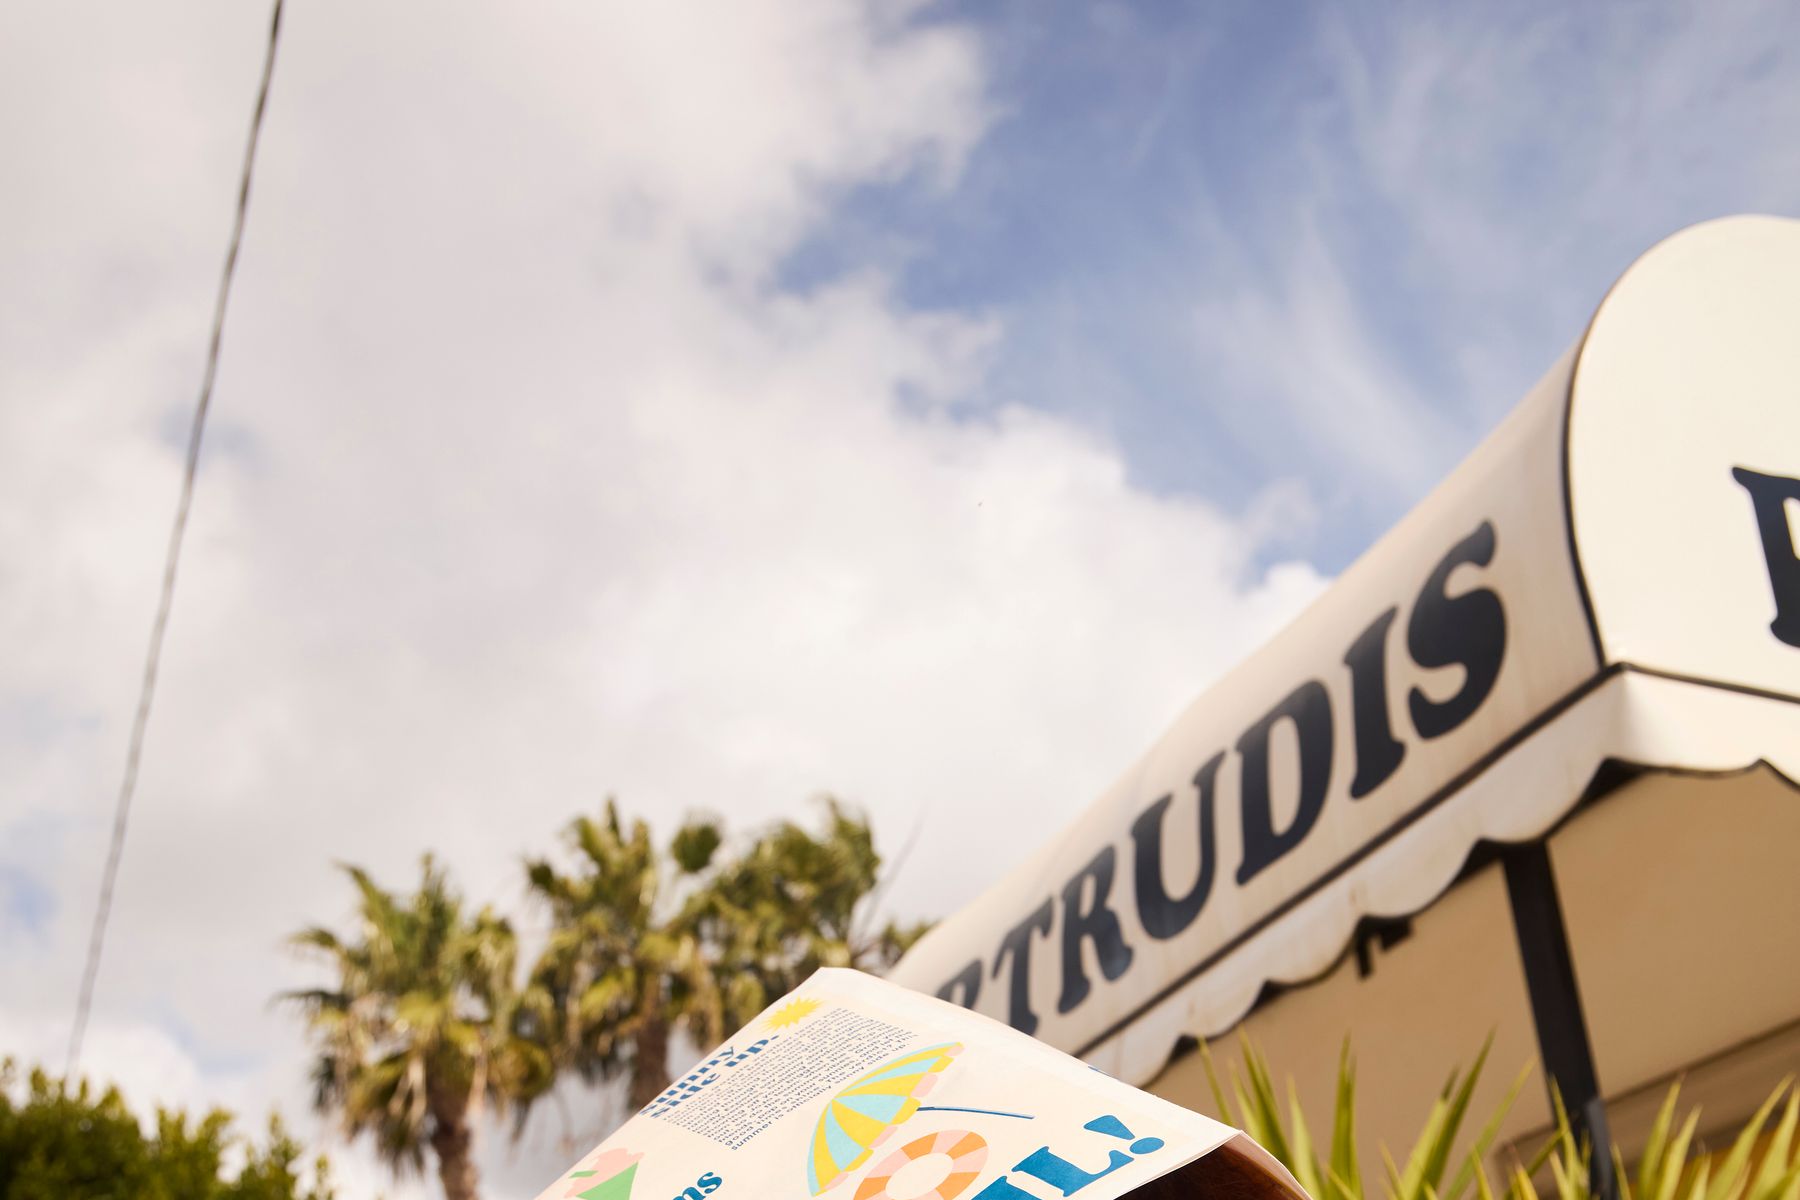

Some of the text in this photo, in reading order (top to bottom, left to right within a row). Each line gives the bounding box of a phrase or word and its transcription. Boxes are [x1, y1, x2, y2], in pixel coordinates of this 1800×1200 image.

[639, 1046, 734, 1115] sunny
[651, 1035, 780, 1118] side up.
[723, 1125, 754, 1147] good
[730, 1118, 773, 1151] summer
